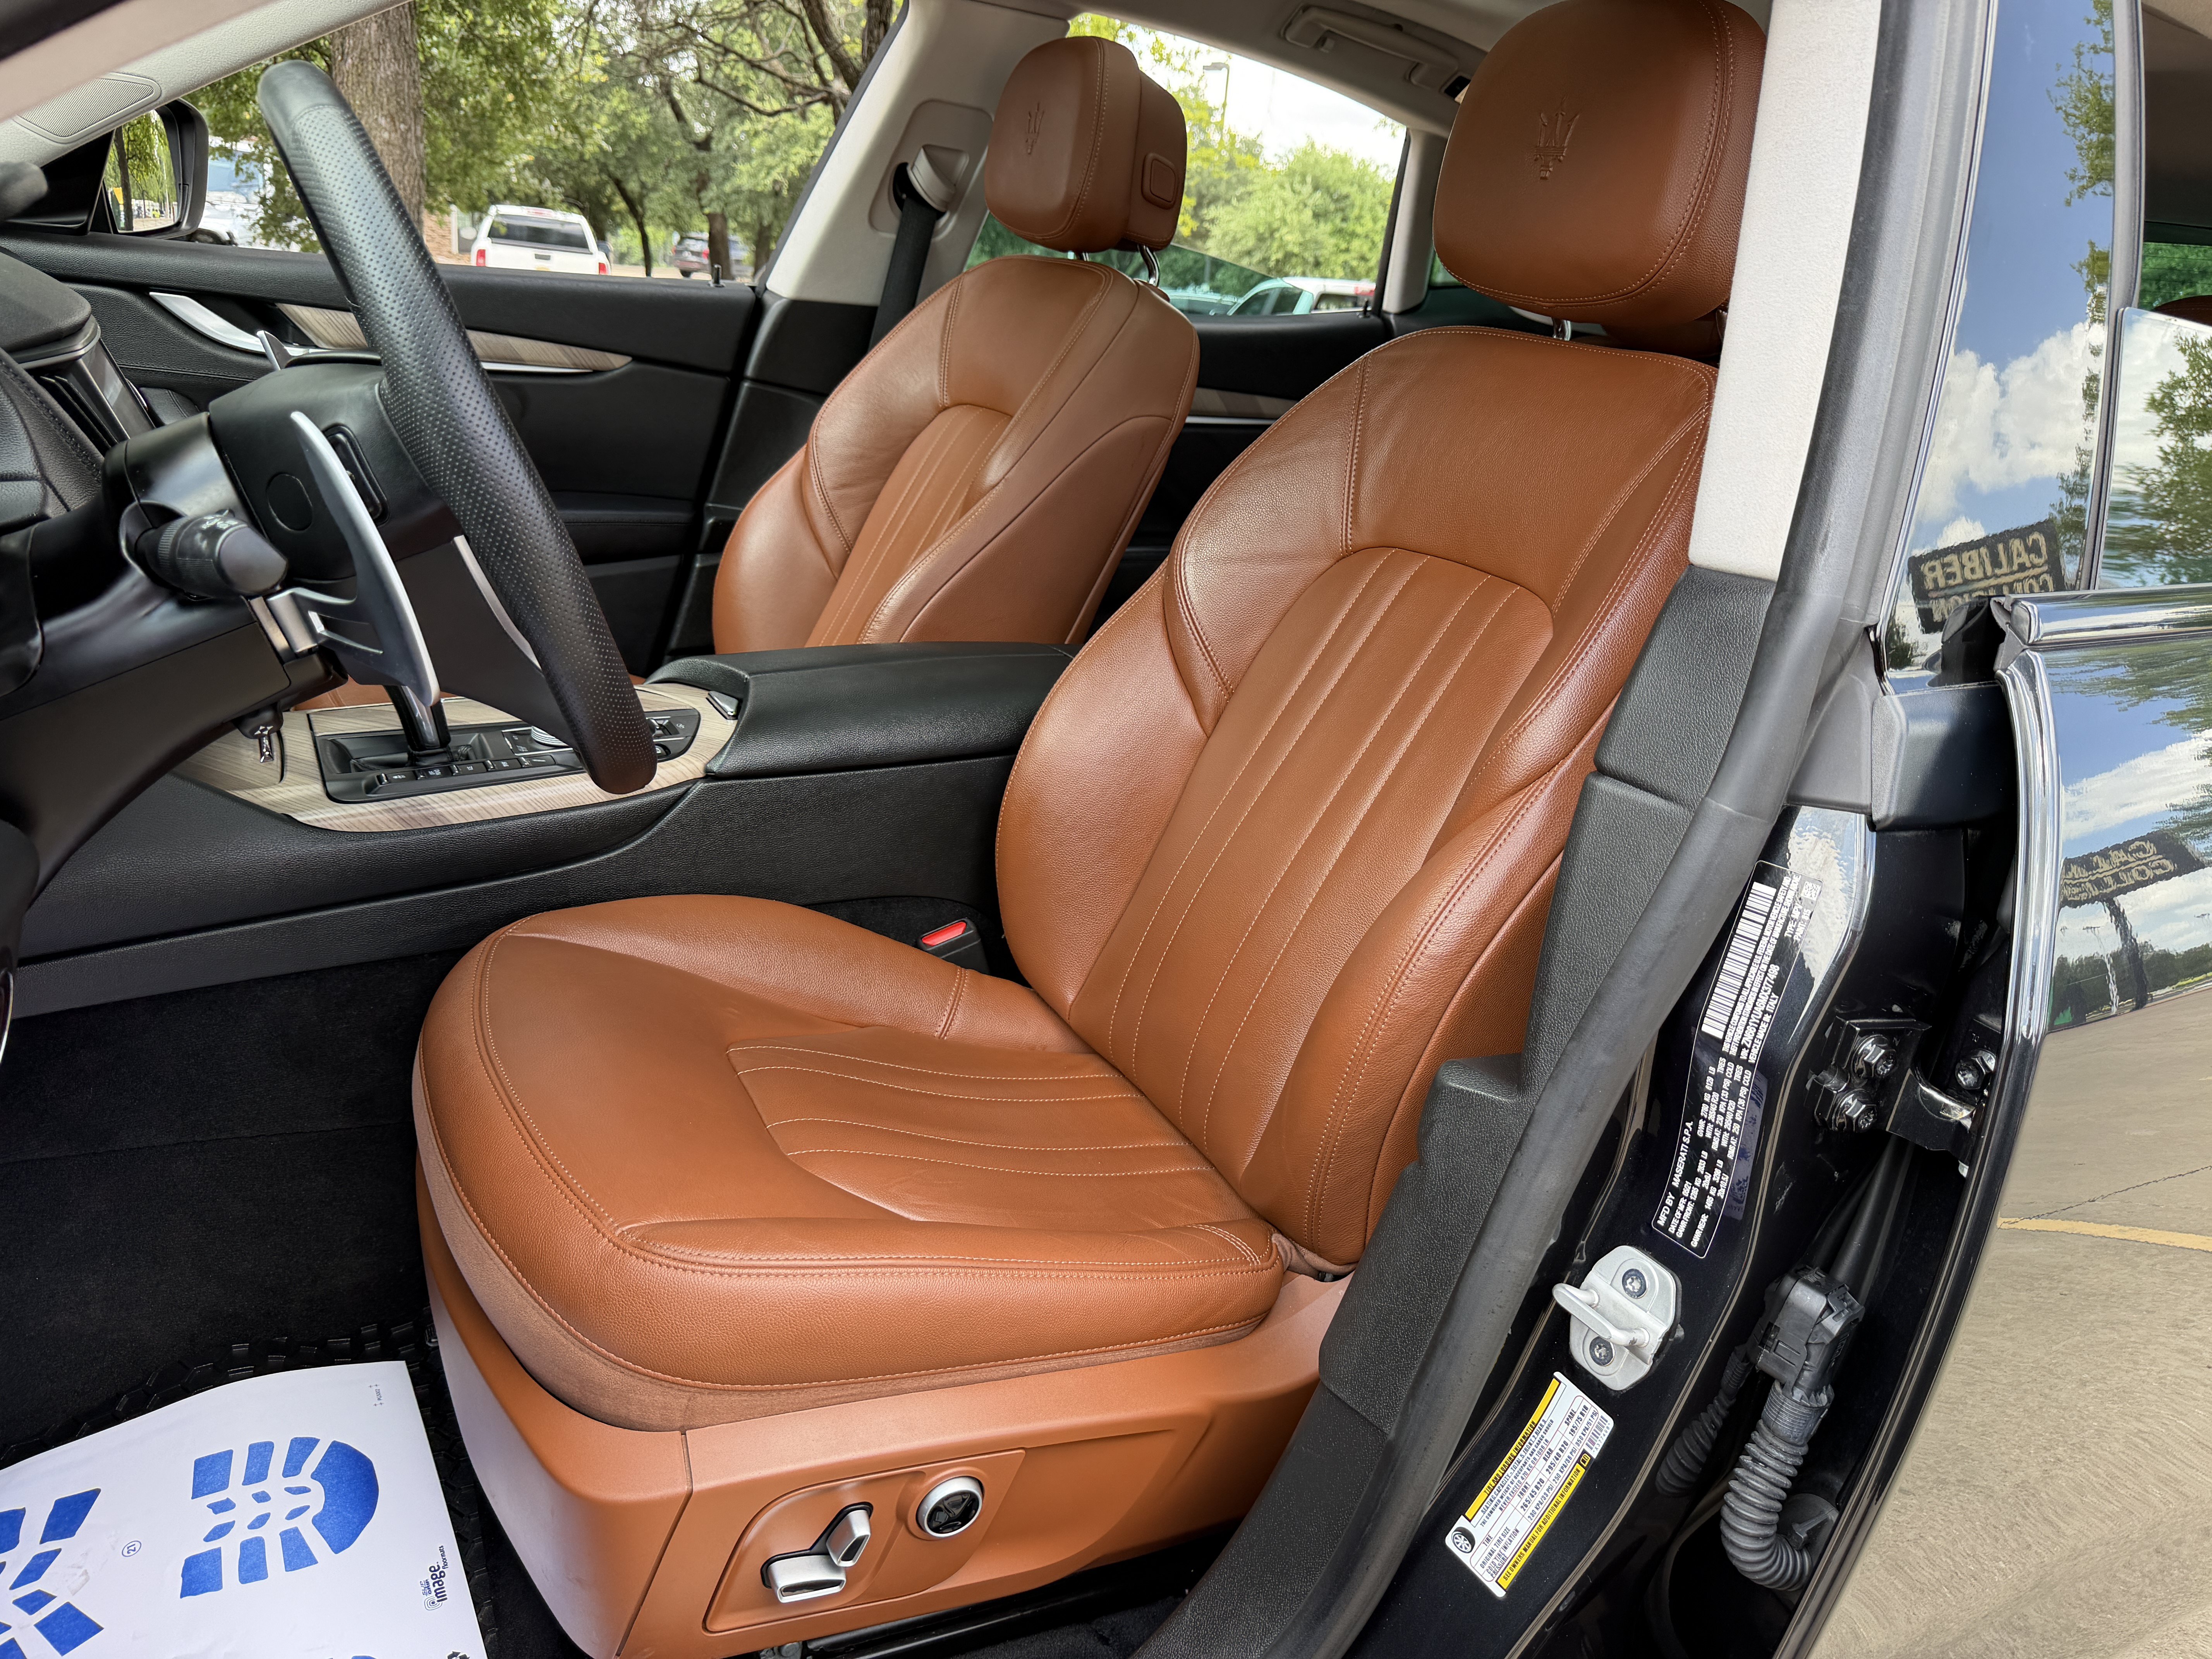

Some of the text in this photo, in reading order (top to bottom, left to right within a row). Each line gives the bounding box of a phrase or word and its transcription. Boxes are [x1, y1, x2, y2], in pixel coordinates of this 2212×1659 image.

[1782, 876, 1791, 887] AND
[1776, 885, 1788, 903] SAFETY
[1783, 890, 1795, 907] SHOWN
[1769, 902, 1781, 920] VEHICLE
[1784, 902, 1803, 937] TYPE: MPV
[1763, 919, 1775, 936] MOTOR
[1772, 906, 1789, 938] MANUFACTURE
[1793, 921, 1807, 941] PAINT:
[1756, 936, 1769, 955] FEDERAL
[1765, 943, 1775, 956] DATE
[1759, 963, 1767, 971] ON
[1761, 954, 1771, 964] THE
[1744, 962, 1759, 988] APPLICABLE
[1753, 970, 1764, 988] EFFECT
[1741, 988, 1750, 996] ALL
[1730, 1001, 1744, 1025] CONFORMS
[1740, 964, 1779, 1059] VIN: ZN661YUA6MX377498
[1742, 991, 1757, 1017] STANDARDS
[1724, 1024, 1736, 1042] VEHICLE
[1733, 1016, 1747, 1043] PREVENTION
[1748, 1038, 1762, 1063] VEHICLE
[1756, 1021, 1768, 1039] MADE
[1765, 992, 1778, 1012] ITALY
[1722, 1042, 1730, 1052] THIS
[1729, 1041, 1738, 1055] THEFT
[1717, 1057, 1726, 1073] TIRES
[1733, 1065, 1743, 1081] TIRES
[1697, 1066, 1715, 1137] GVWR: 2780 KG 6129 LB
[1711, 1092, 1719, 1104] R20
[1711, 1136, 1719, 1151] RIMS
[1716, 1114, 1724, 1126] 230
[1725, 1062, 1734, 1078] COLD
[1727, 1100, 1735, 1112] R20
[1708, 1103, 1717, 1122] 265/45
[1724, 1111, 1733, 1130] 295/40
[1727, 1145, 1735, 1159] RIMS
[1732, 1123, 1740, 1135] 250
[1742, 1070, 1751, 1085] COLD
[1701, 1150, 1707, 1159] LB
[1716, 1159, 1723, 1168] LB
[1657, 1121, 1693, 1226] MFD BY MASERATI S.P.A.
[1697, 1159, 1705, 1174] 2833
[1694, 1177, 1701, 1187] KG
[1709, 1186, 1716, 1196] KG
[1690, 1186, 1698, 1200] 1285
[1705, 1195, 1714, 1209] 1495
[1668, 1180, 1692, 1233] DATE OF MFR: 05/21
[1683, 1201, 1694, 1221] FRONT:
[1676, 1220, 1687, 1237] GAWR
[1698, 1213, 1708, 1230] REAR:
[1691, 1229, 1702, 1247] GAWR
[1553, 1473, 1561, 1484] 250
[1590, 1410, 1598, 1420] PSI
[1484, 1420, 1536, 1496] TIRE AND LOADING INFORMATION
[1481, 1495, 1495, 1514] SEATING
[1494, 1474, 1510, 1495] CAPACITY
[1510, 1458, 1521, 1471] TOTAL
[1522, 1438, 1533, 1454] FRONT
[1535, 1423, 1544, 1435] REAR
[1482, 1408, 1576, 1546] TIRE FRONT REAR SPARE
[1486, 1499, 1501, 1519] COMBINED
[1499, 1484, 1511, 1499] WEIGHT
[1513, 1456, 1530, 1479] OCCUPANTS
[1534, 1434, 1544, 1448] CARGO
[1543, 1419, 1553, 1435] SHOULD
[1480, 1547, 1496, 1568] ORIGINAL
[1494, 1536, 1503, 1548] TIRE
[1501, 1526, 1510, 1538] SIZE
[1520, 1489, 1537, 1511] 265/45
[1534, 1478, 1544, 1491] R20
[1546, 1452, 1561, 1474] 295/40
[1558, 1440, 1568, 1453] R20
[1569, 1415, 1582, 1436] 195/75
[1499, 1496, 1510, 1511] NEVER
[1508, 1480, 1522, 1497] EXCEED
[1503, 1468, 1580, 1580] SEE OWNERS MANUAL FOR ADDITIONAL INFORMATION
[438, 1545, 449, 1569] floormats
[1486, 1527, 1519, 1574] COLD TIRE INFLATION
[1490, 1554, 1508, 1578] PRESSURE
